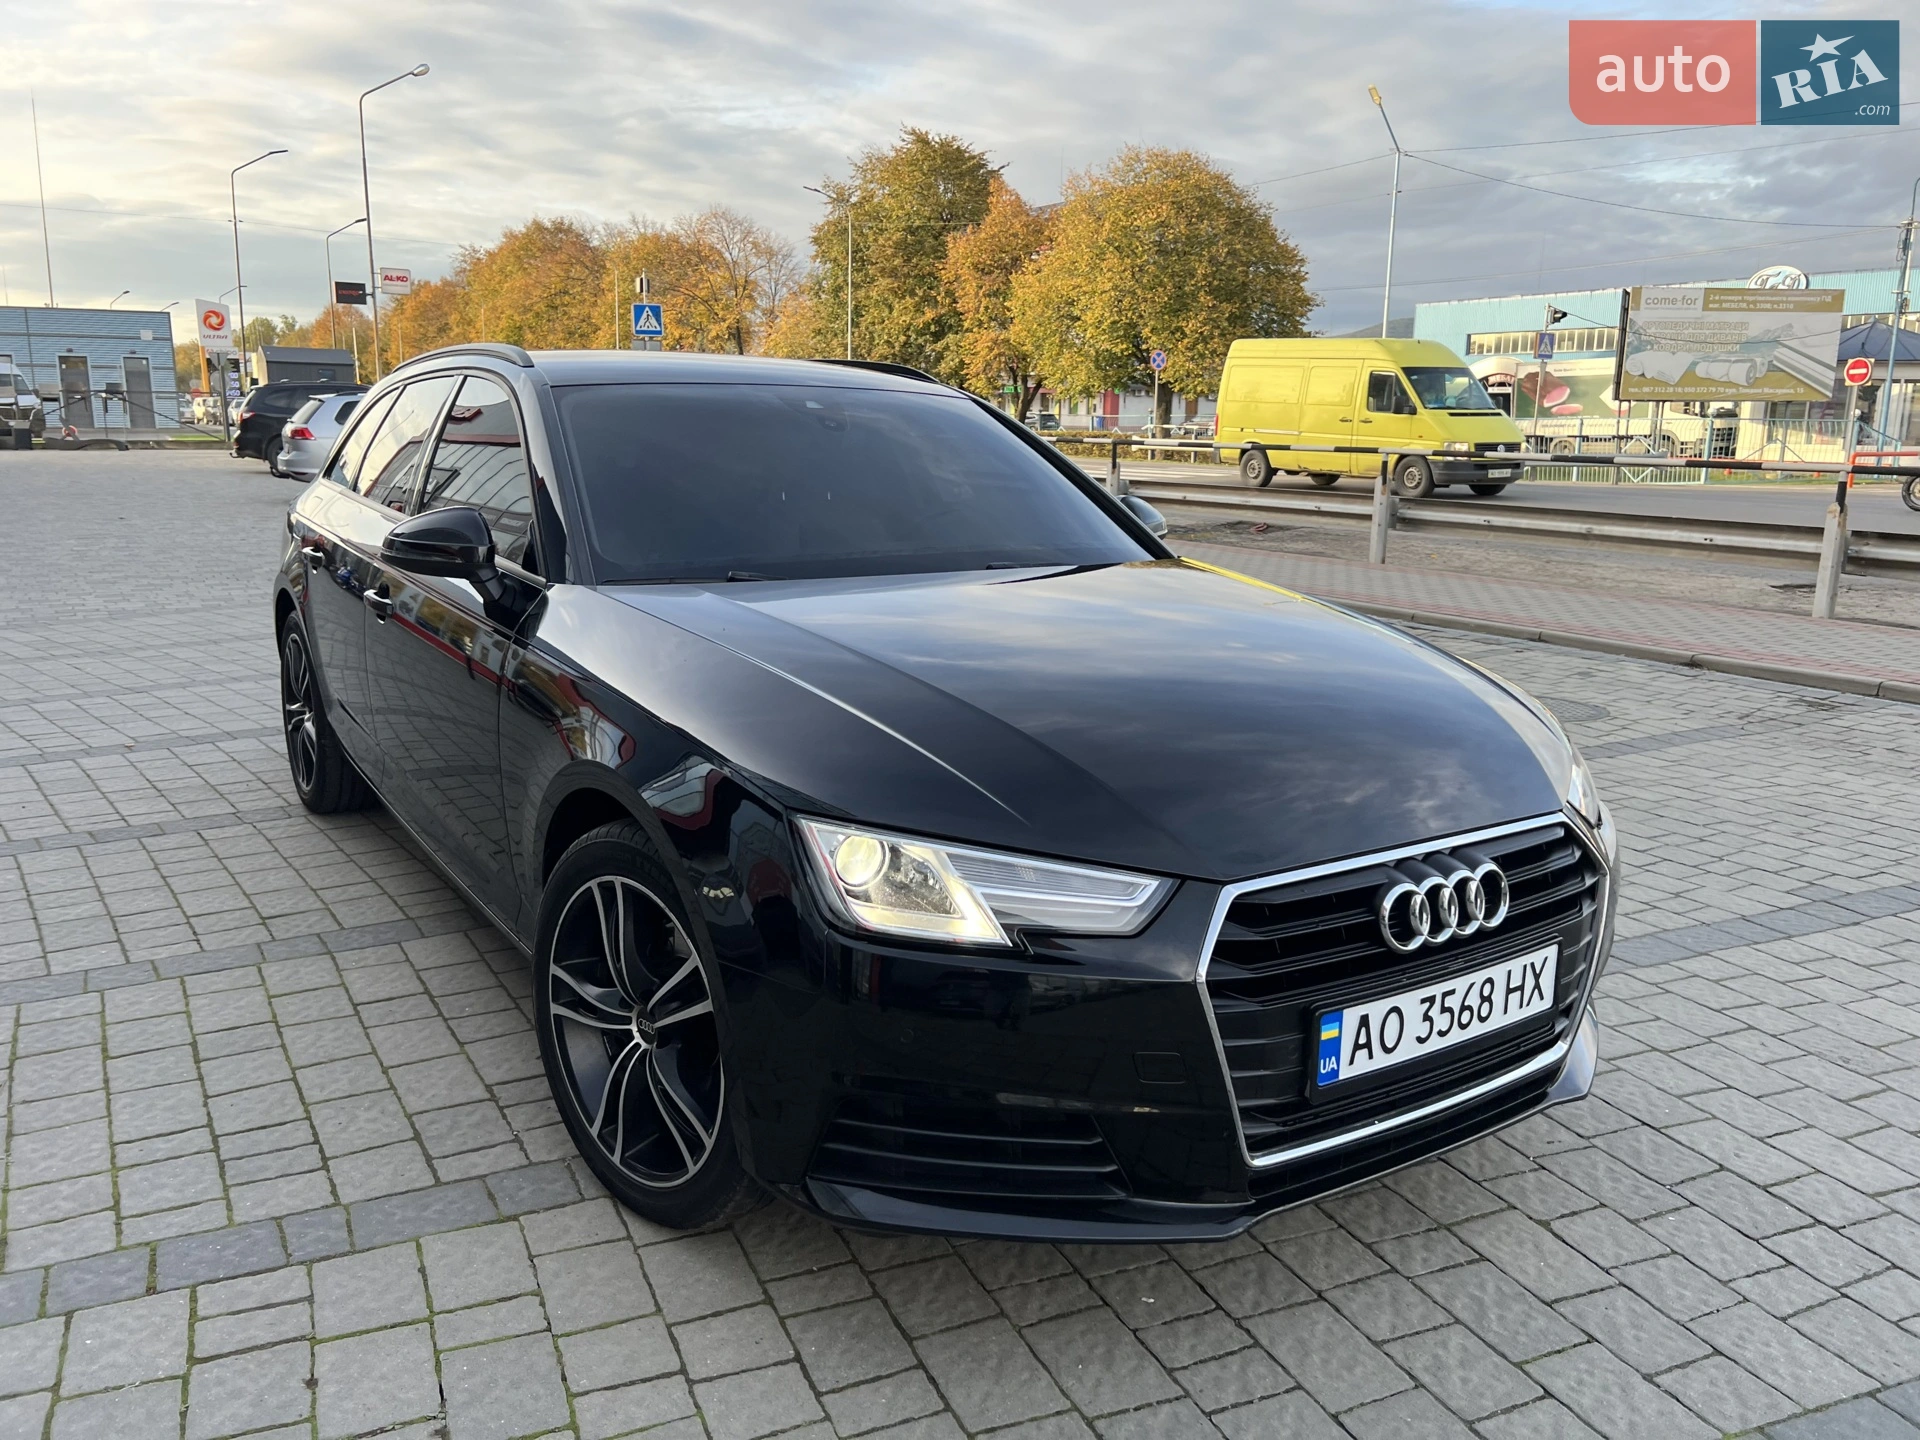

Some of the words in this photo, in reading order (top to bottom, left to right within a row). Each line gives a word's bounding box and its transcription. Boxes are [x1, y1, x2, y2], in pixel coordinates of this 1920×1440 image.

[1642, 321, 1706, 331] ОРТОПЕДИЧНІ
[1707, 321, 1749, 331] МАТРАЦИ
[1708, 333, 1747, 342] ДИВАНІВ
[1693, 343, 1740, 353] ПОДУШКИ
[1349, 1006, 1404, 1066] AO
[1416, 977, 1495, 1044] 3568
[1503, 956, 1548, 1015] HX
[1320, 1056, 1338, 1074] UA
